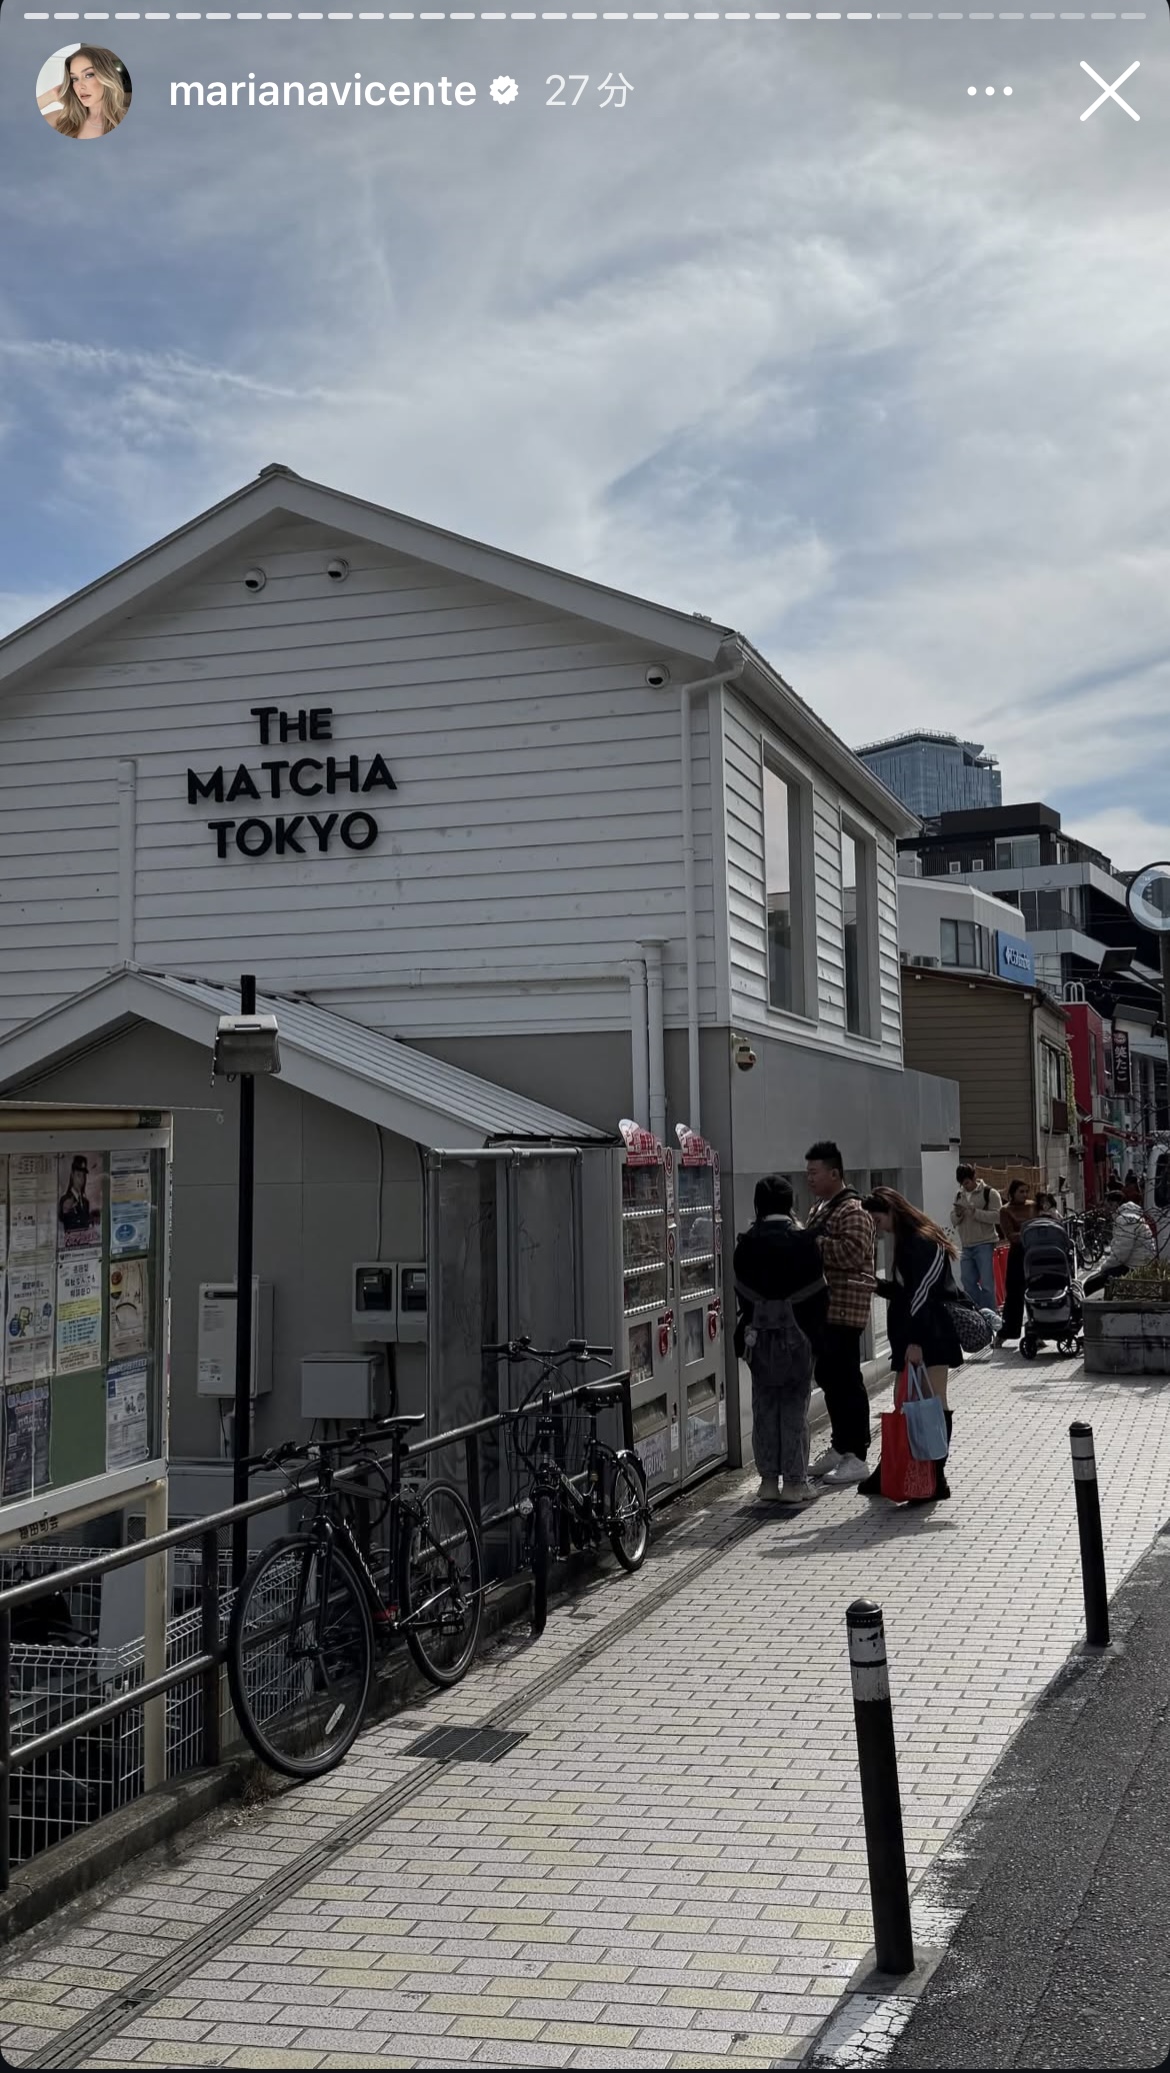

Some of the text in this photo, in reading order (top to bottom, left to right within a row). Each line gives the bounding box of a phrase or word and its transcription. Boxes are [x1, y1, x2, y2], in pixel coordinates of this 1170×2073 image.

[250, 706, 333, 745] THE
[187, 753, 398, 805] MATCHA
[207, 811, 379, 859] TOKYO
[1114, 1045, 1128, 1081] 笑たこ
